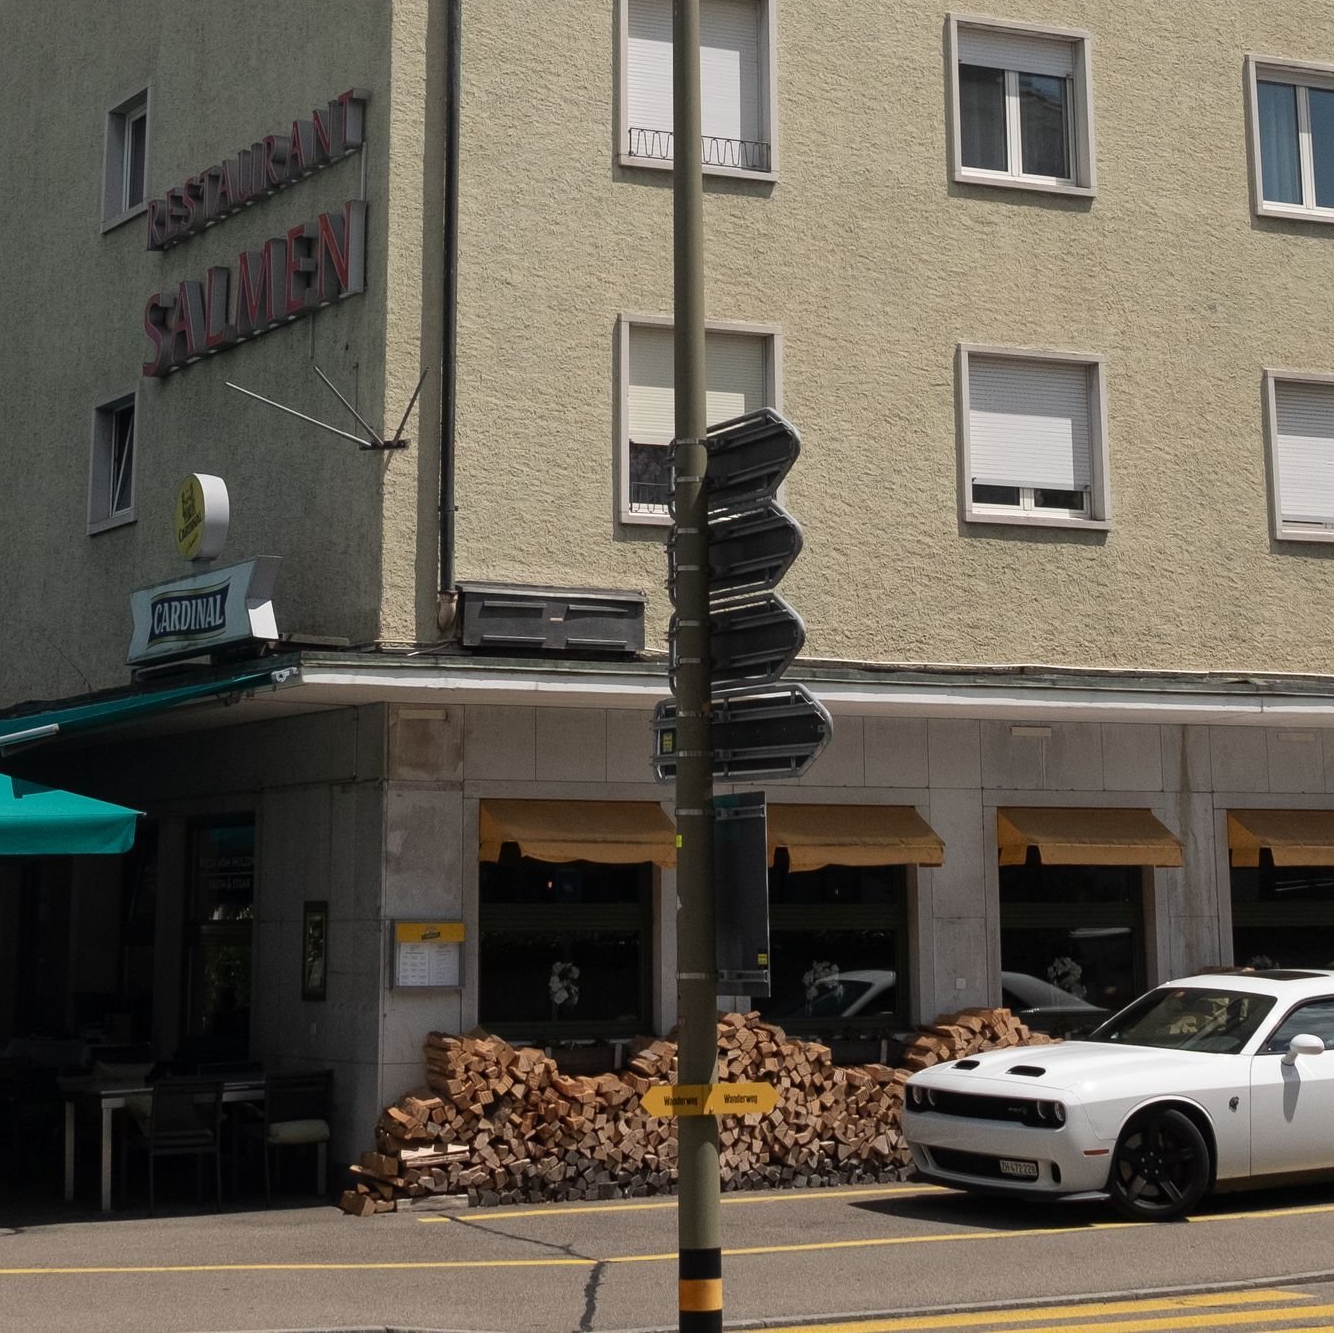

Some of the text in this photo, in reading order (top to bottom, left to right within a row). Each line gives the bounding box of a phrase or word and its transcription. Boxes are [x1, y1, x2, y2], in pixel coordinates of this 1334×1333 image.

[146, 87, 370, 251] RESTAURANT
[142, 200, 367, 377] SALMEN
[153, 594, 224, 635] CARDINAL
[663, 1096, 698, 1106] Wanderweg
[723, 1094, 758, 1104] Wanderweg
